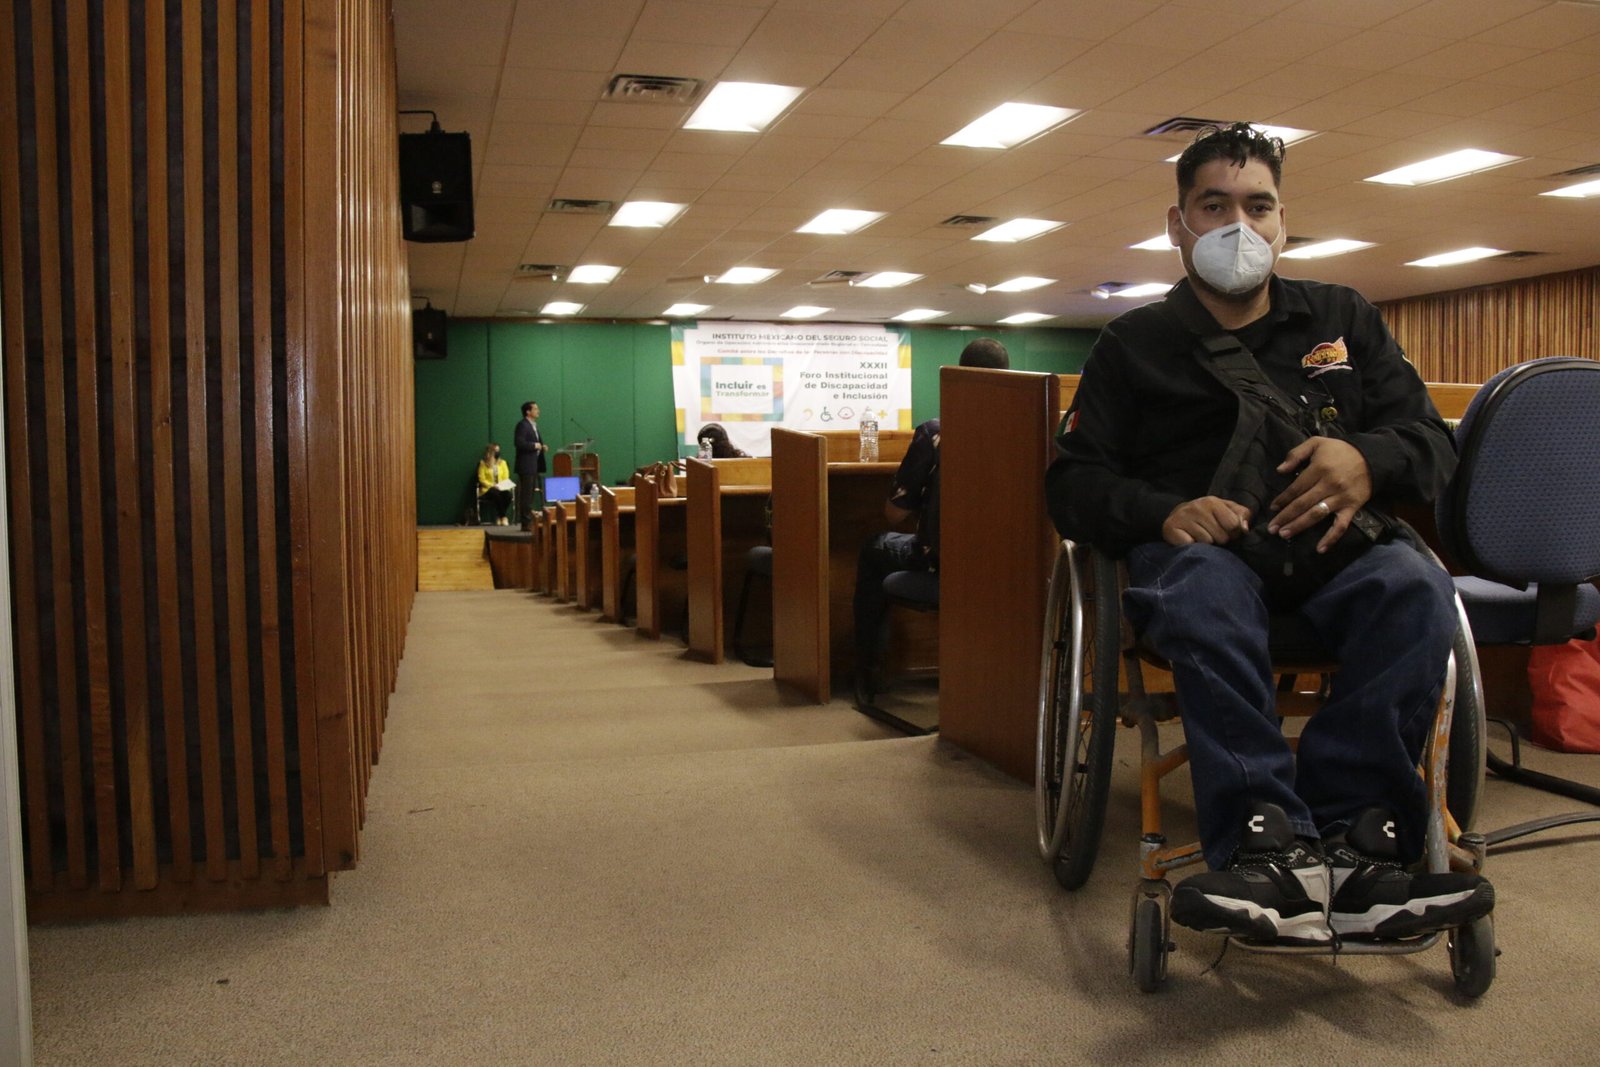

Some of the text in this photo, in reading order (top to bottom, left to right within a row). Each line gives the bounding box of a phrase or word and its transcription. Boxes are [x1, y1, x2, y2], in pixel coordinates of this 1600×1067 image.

[859, 361, 888, 369] XXXII
[799, 371, 888, 379] Foro Institucional
[715, 380, 753, 389] Incluir
[820, 382, 888, 391] Discapacidad
[842, 392, 888, 400] Inclusión
